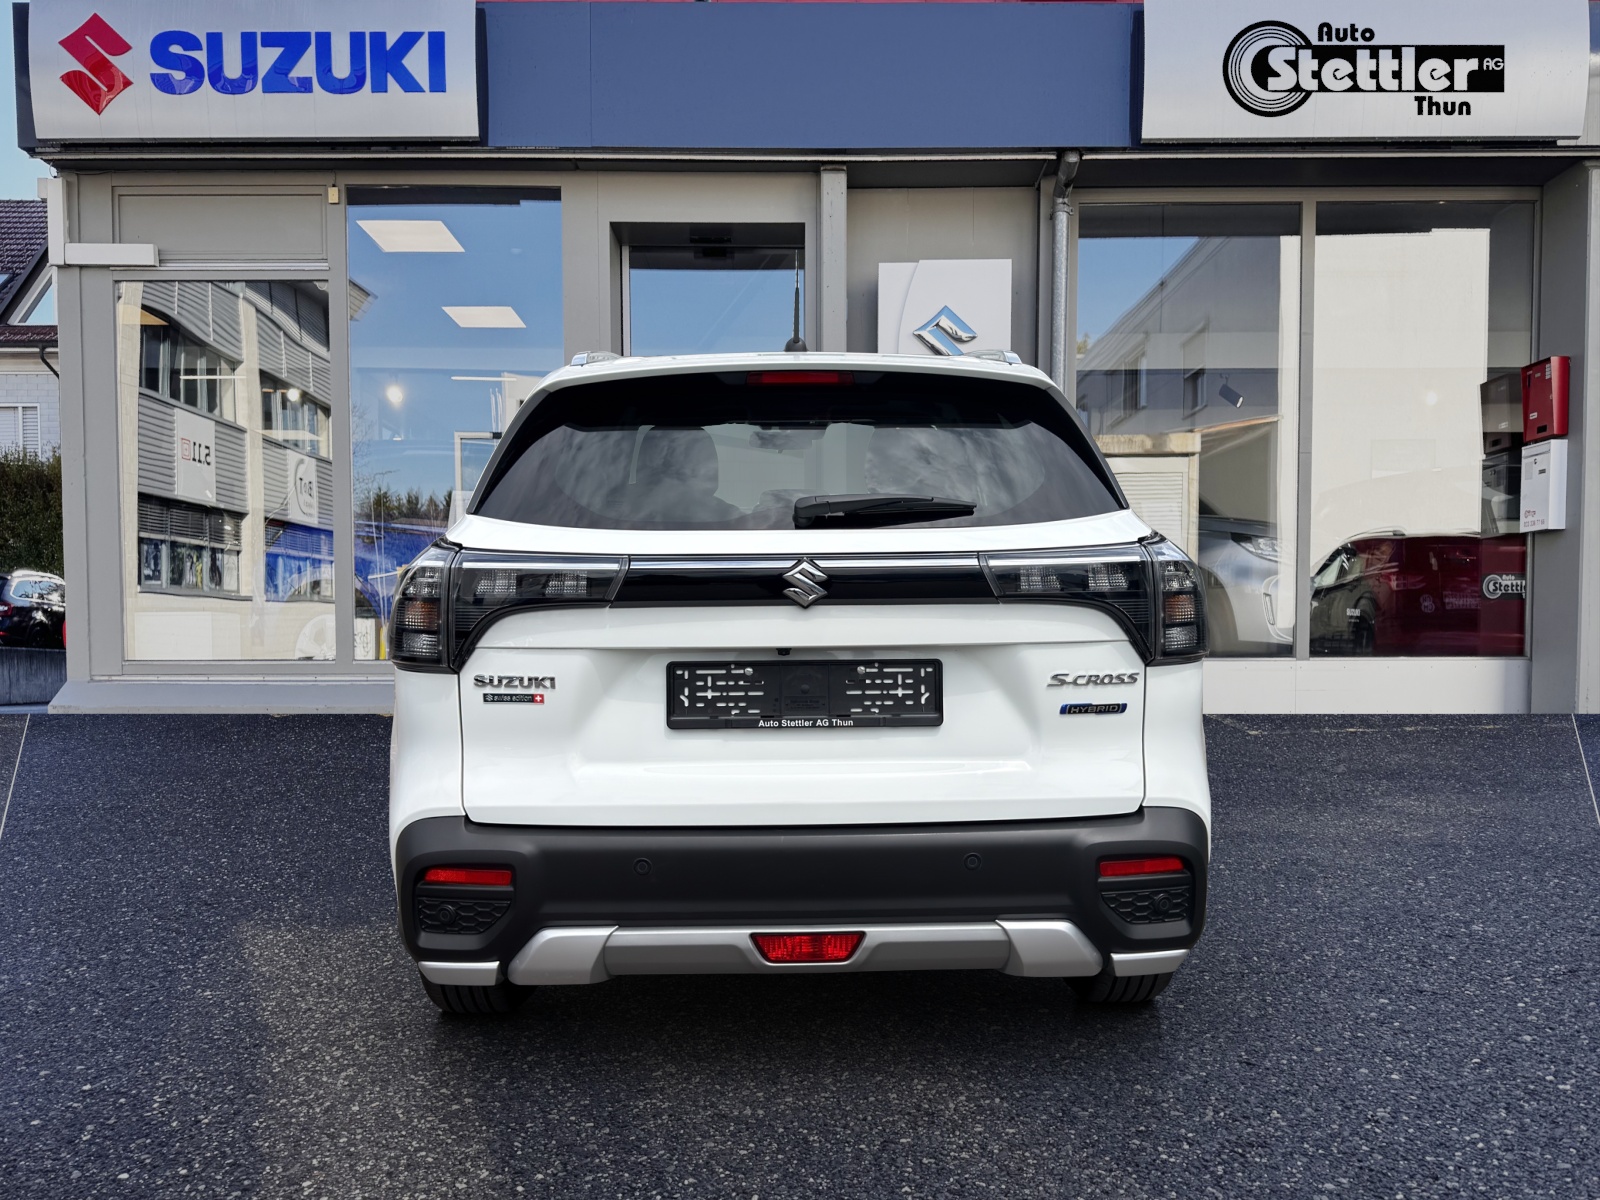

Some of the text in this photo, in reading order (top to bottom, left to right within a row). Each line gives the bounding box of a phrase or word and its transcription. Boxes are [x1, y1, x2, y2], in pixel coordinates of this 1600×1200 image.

[1317, 22, 1376, 43] Auto
[149, 30, 447, 95] SUZUKI
[1267, 46, 1504, 92] Stettler AG
[1414, 96, 1472, 116] Thun
[1492, 581, 1526, 592] Stettl
[473, 674, 556, 690] SUZUKI
[494, 694, 533, 702] swiss edition
[1070, 704, 1119, 714] HYBRID
[758, 718, 854, 728] Auto Stettler AG Thun
